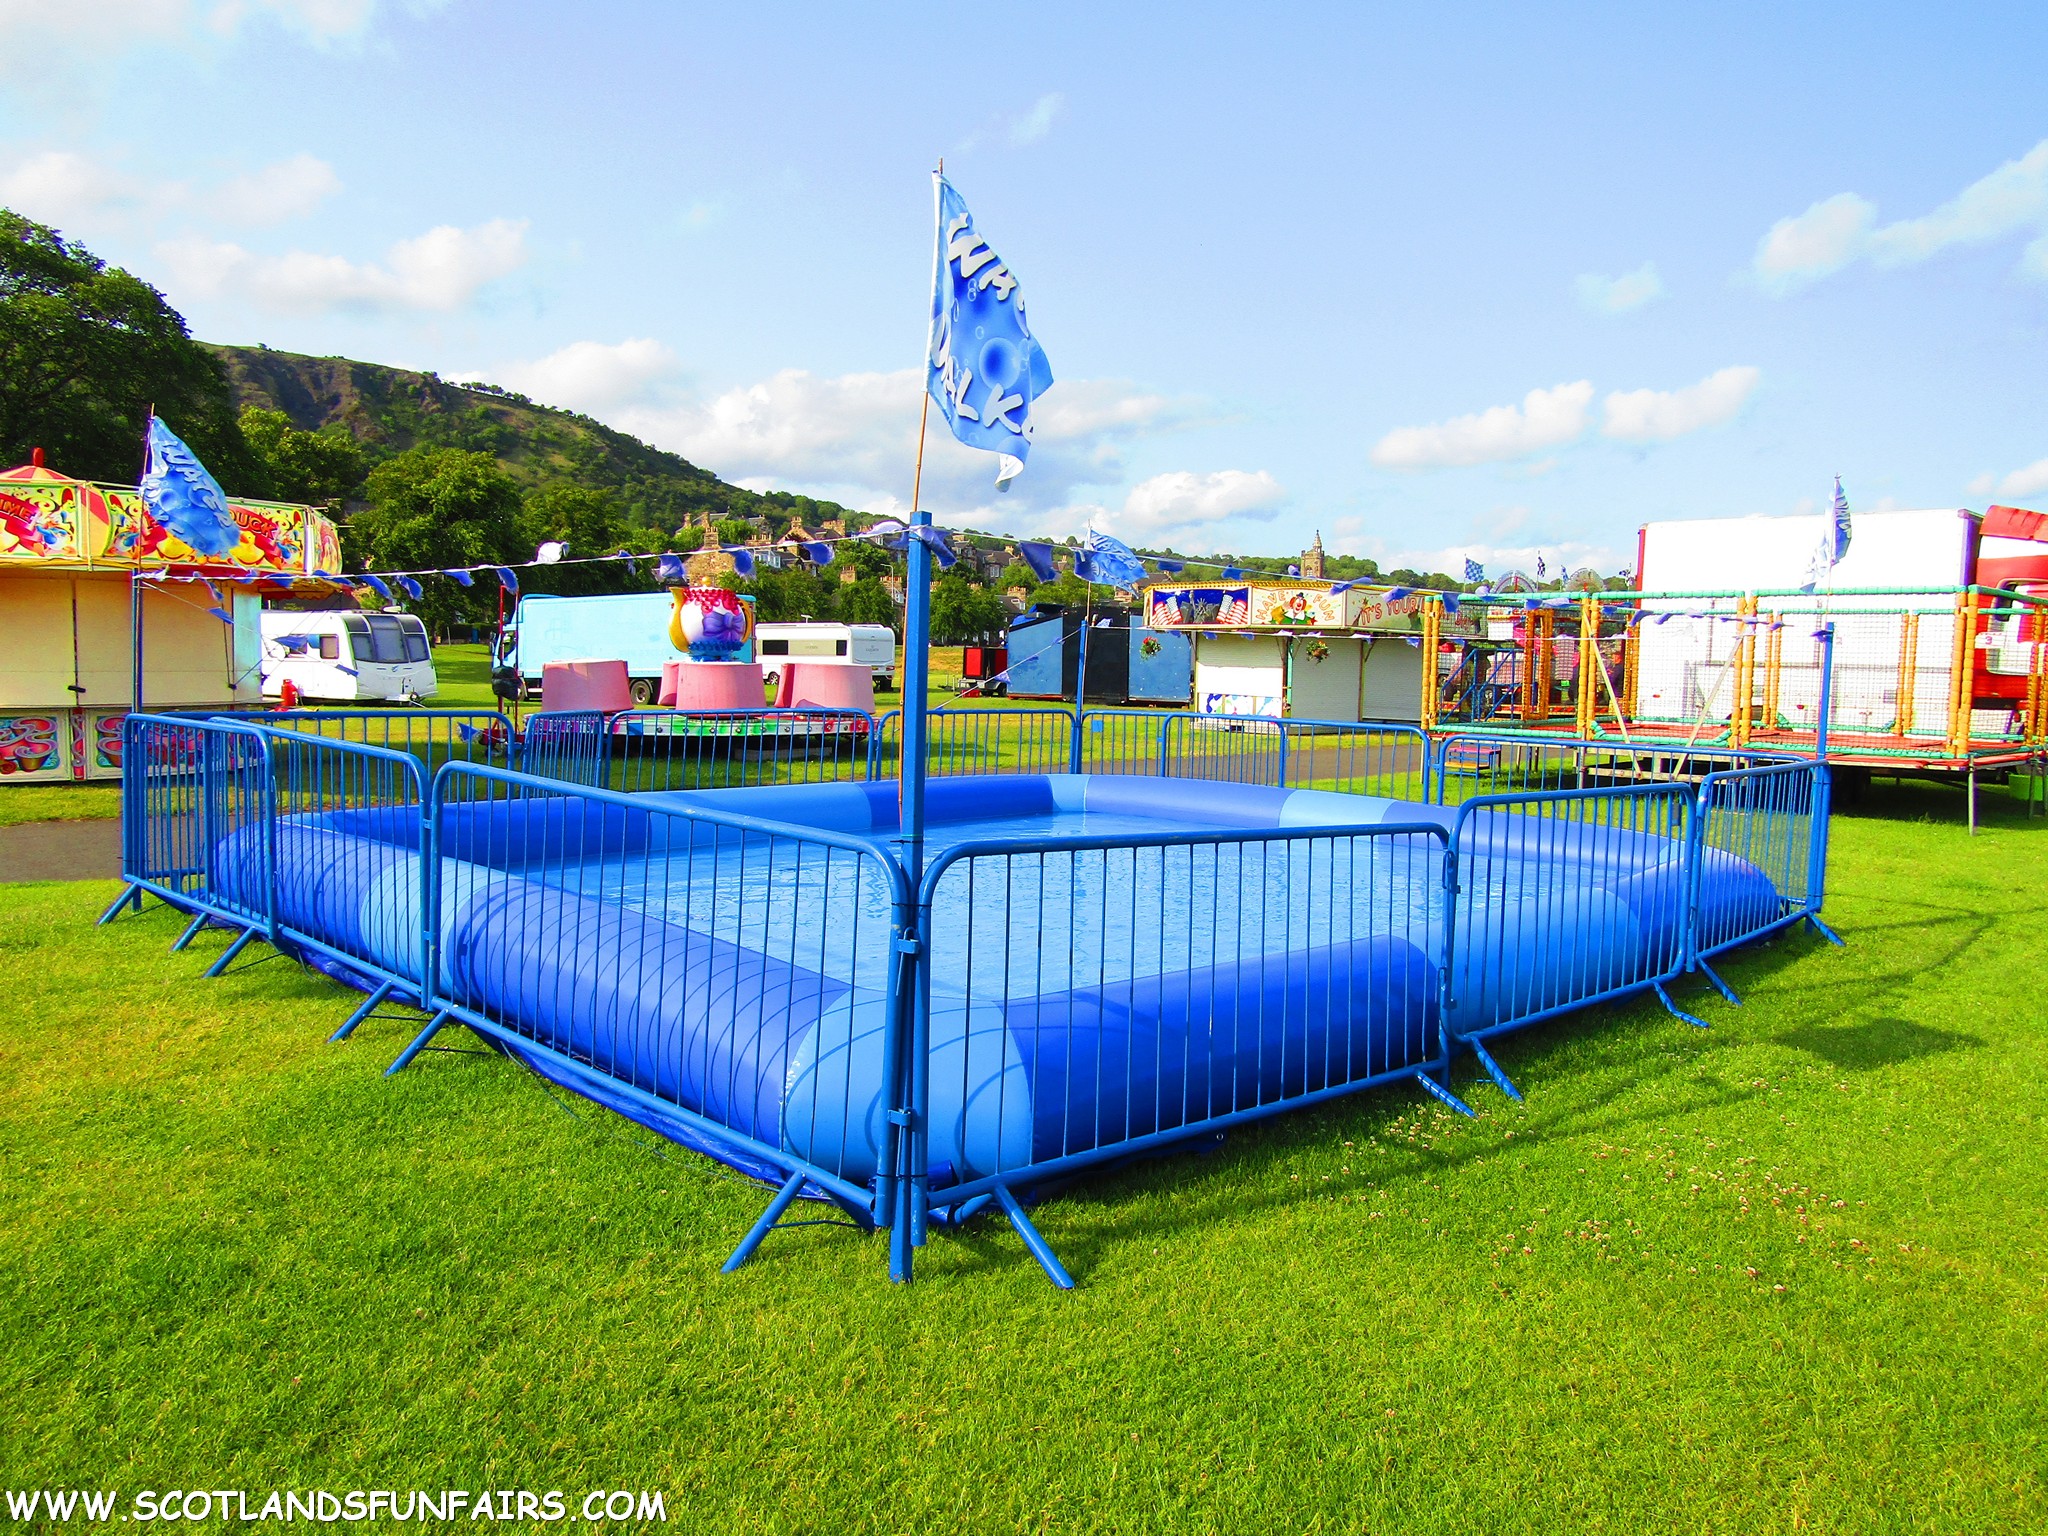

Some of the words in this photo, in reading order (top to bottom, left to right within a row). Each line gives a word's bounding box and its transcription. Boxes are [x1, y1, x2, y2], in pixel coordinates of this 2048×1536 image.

[1256, 590, 1287, 620] HAVE
[1313, 594, 1336, 621] FUN
[1360, 602, 1383, 625] IT'S
[1387, 597, 1418, 616] YOUR
